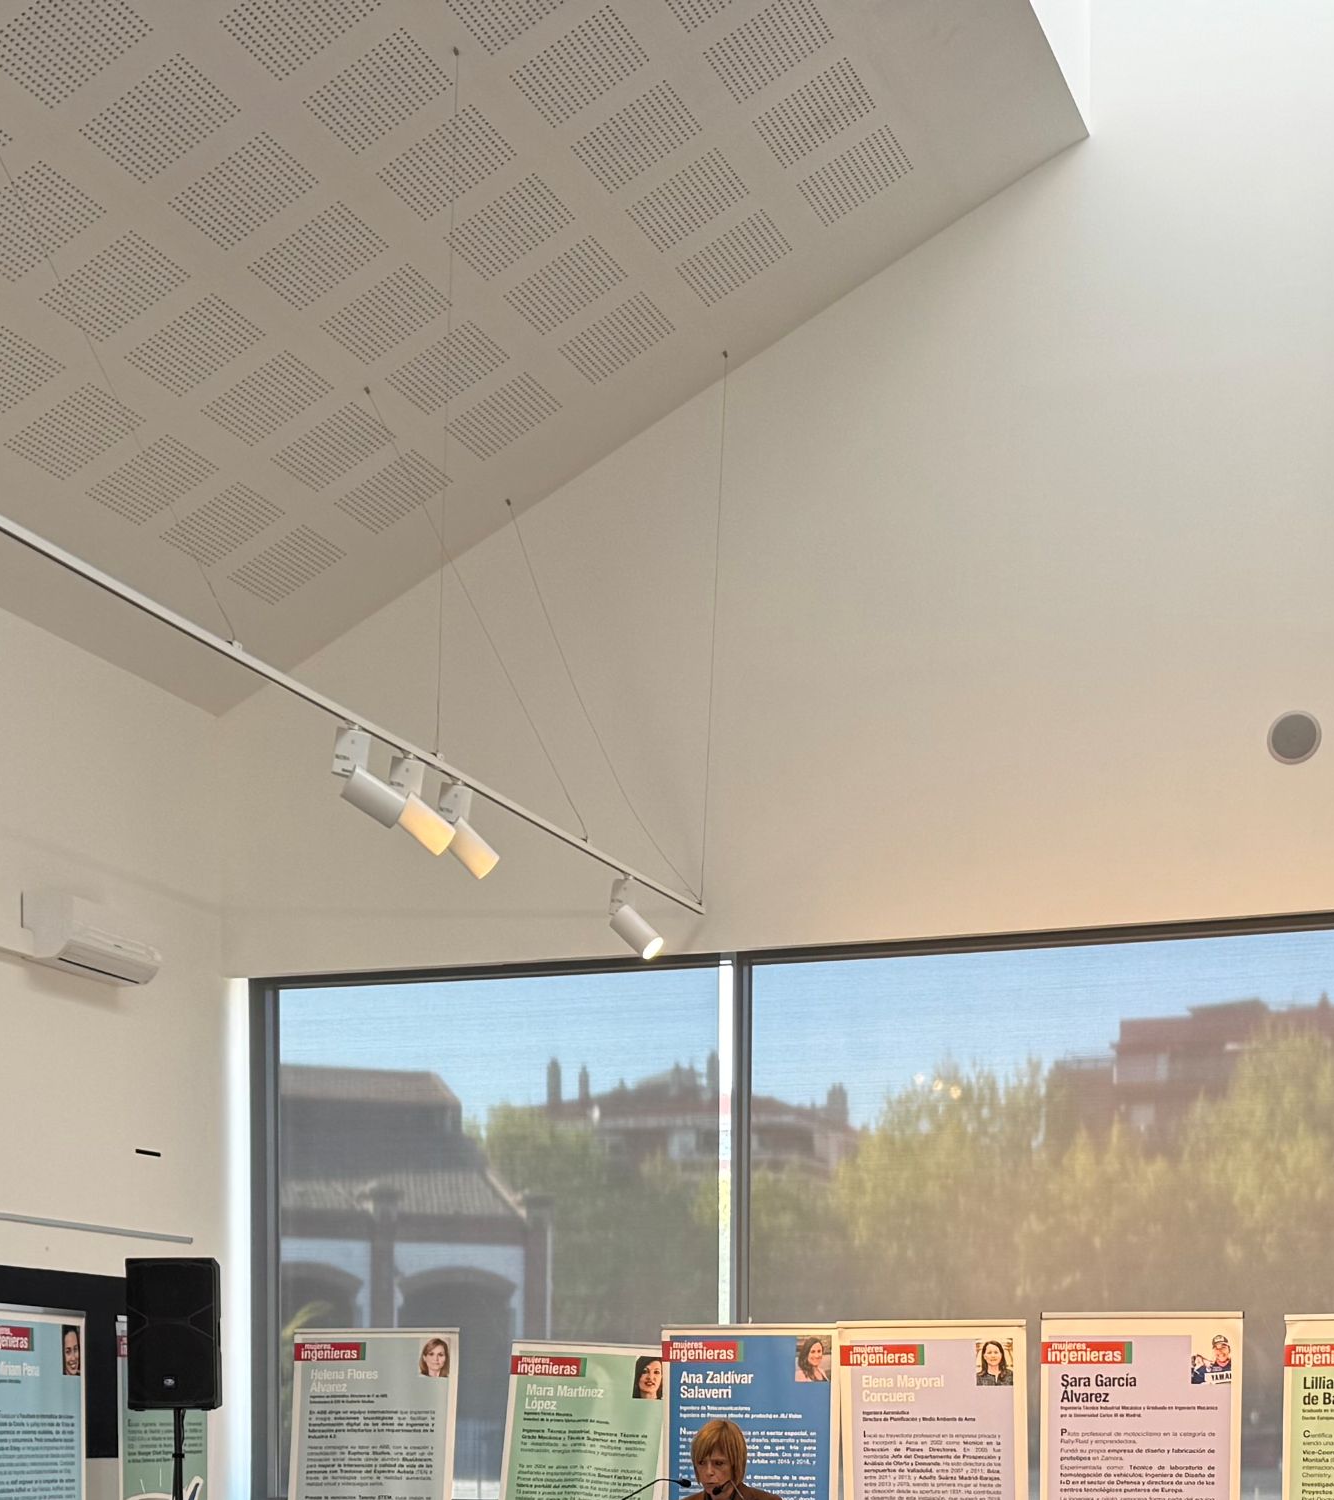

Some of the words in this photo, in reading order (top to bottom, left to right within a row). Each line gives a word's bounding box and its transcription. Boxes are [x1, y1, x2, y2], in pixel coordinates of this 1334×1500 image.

[673, 1341, 703, 1349] mujeres
[1052, 1343, 1086, 1351] mujeres
[1296, 1345, 1331, 1354] mujeres
[301, 1347, 357, 1361] ingenieras
[522, 1356, 550, 1364] mujeres
[669, 1347, 734, 1362] ingenieras
[849, 1350, 915, 1366] ingenieras
[1048, 1348, 1121, 1364] ingenieras
[311, 1369, 344, 1380] Helena
[347, 1369, 378, 1380] Flores
[517, 1361, 577, 1376] ingenieras
[681, 1371, 703, 1384] Ana
[706, 1370, 754, 1384] Zaldívar
[862, 1375, 893, 1387] Elena
[897, 1375, 944, 1389] Mayoral
[1061, 1374, 1091, 1388] Sara
[1095, 1372, 1137, 1387] García
[310, 1380, 347, 1392] Álvarez
[526, 1384, 553, 1396] Mara
[557, 1385, 604, 1398] Martínez
[680, 1386, 732, 1398] Salaverri
[862, 1390, 915, 1402] Corcuera
[1061, 1388, 1109, 1403] Álvarez
[1303, 1393, 1318, 1405] de
[525, 1397, 557, 1411] López
